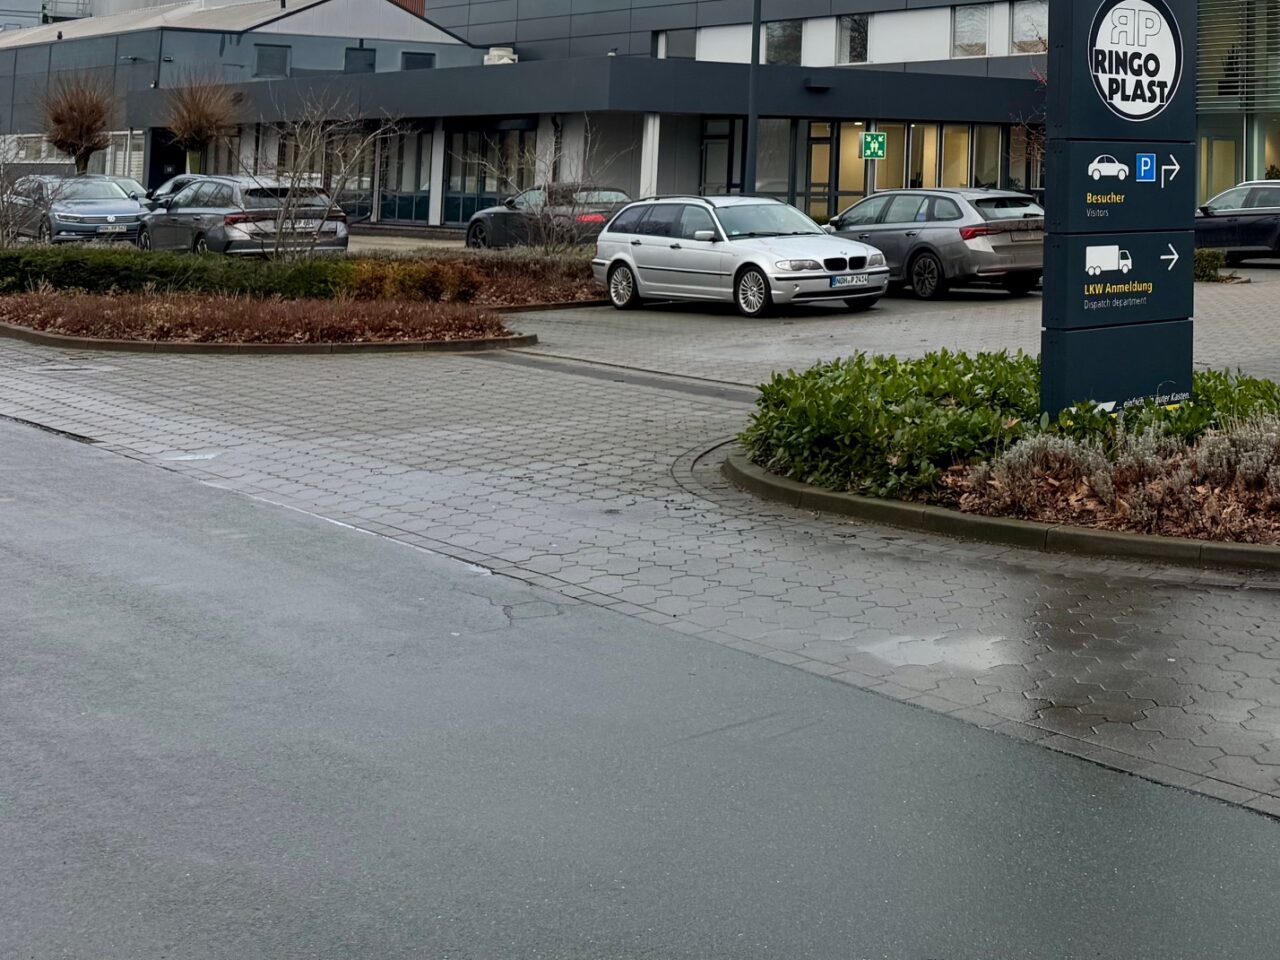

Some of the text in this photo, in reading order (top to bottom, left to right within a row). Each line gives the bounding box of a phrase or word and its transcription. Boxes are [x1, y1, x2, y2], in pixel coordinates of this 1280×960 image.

[1094, 49, 1161, 78] RINGO
[1107, 78, 1168, 103] PLAST
[1141, 157, 1151, 177] P
[1086, 192, 1125, 204] Besucher
[1086, 209, 1109, 217] Visitors
[1084, 281, 1153, 295] LKW Anmeldung
[1084, 296, 1147, 310] Dispatch department
